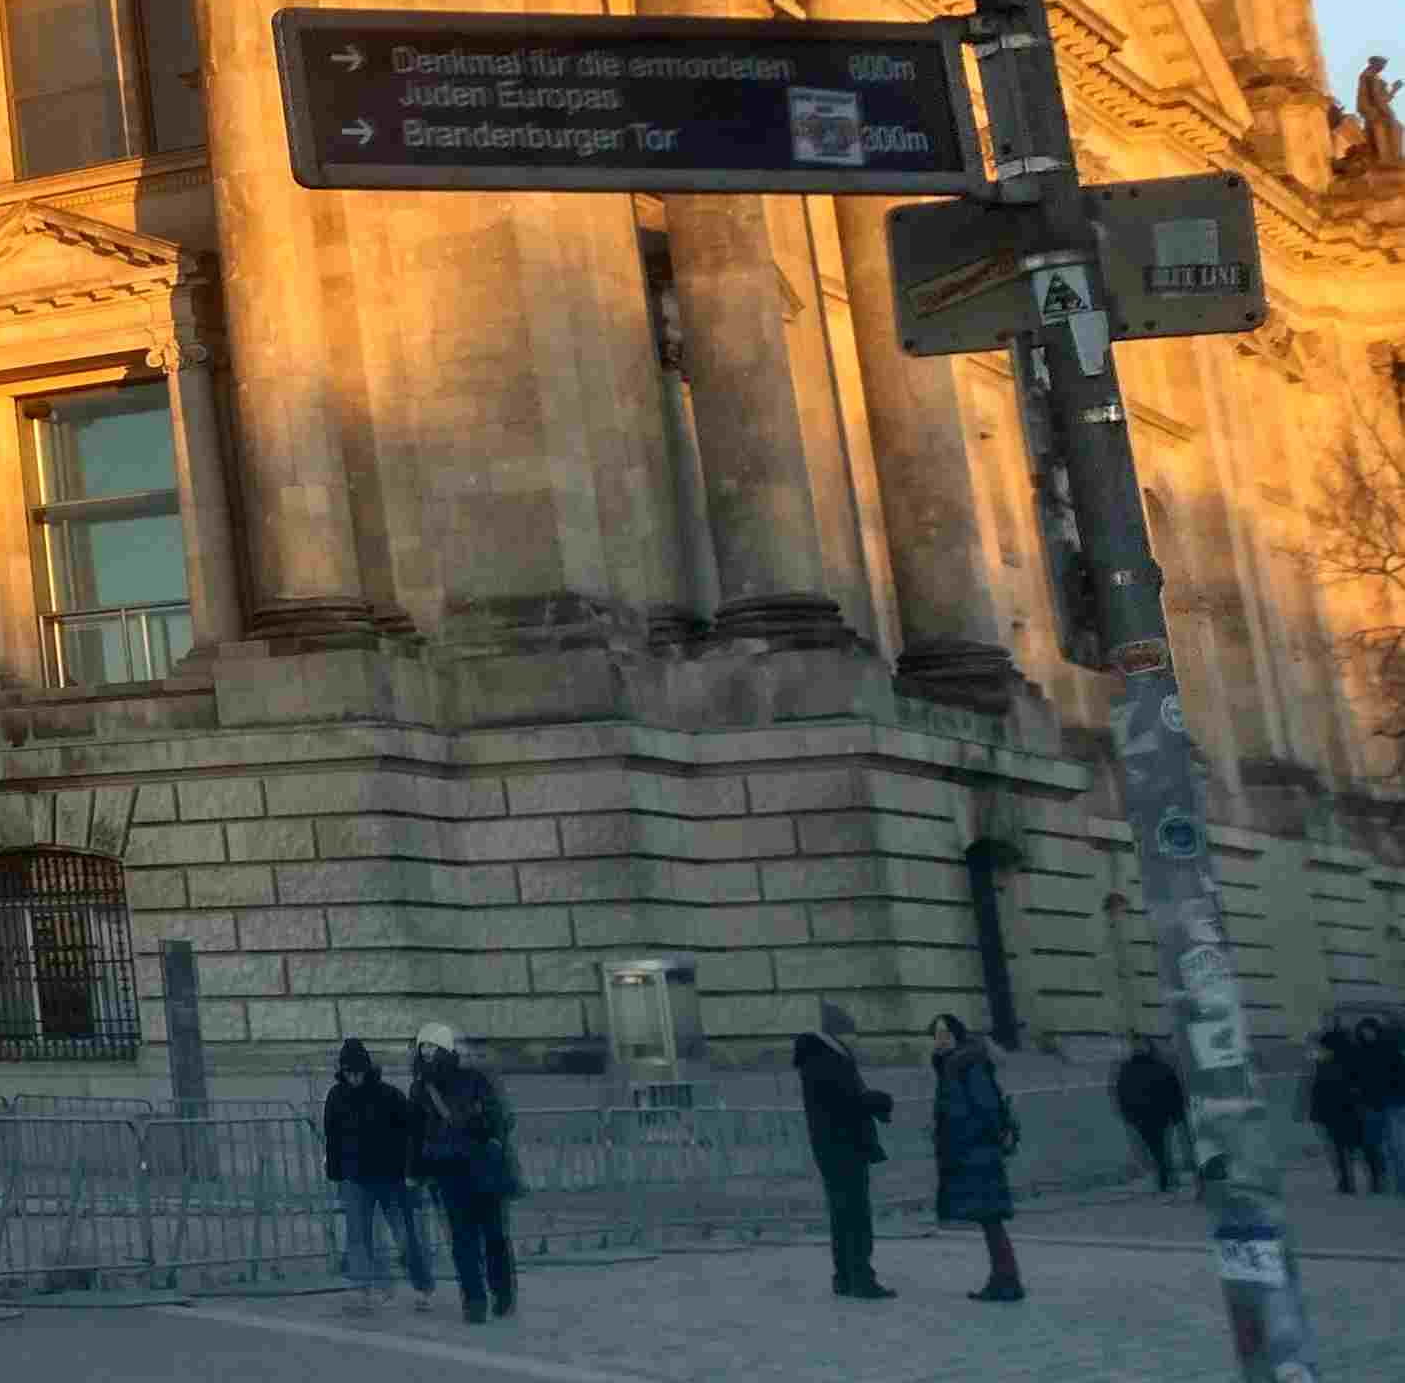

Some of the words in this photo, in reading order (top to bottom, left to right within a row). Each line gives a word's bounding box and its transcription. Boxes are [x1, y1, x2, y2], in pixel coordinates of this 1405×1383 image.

[391, 46, 525, 76] Denkmal
[528, 48, 568, 76] für
[577, 50, 621, 78] die
[629, 50, 790, 80] ermordeten
[399, 79, 487, 108] Juden
[496, 81, 622, 114] Europas
[402, 118, 623, 157] Brandenburger
[629, 122, 678, 151] Tor
